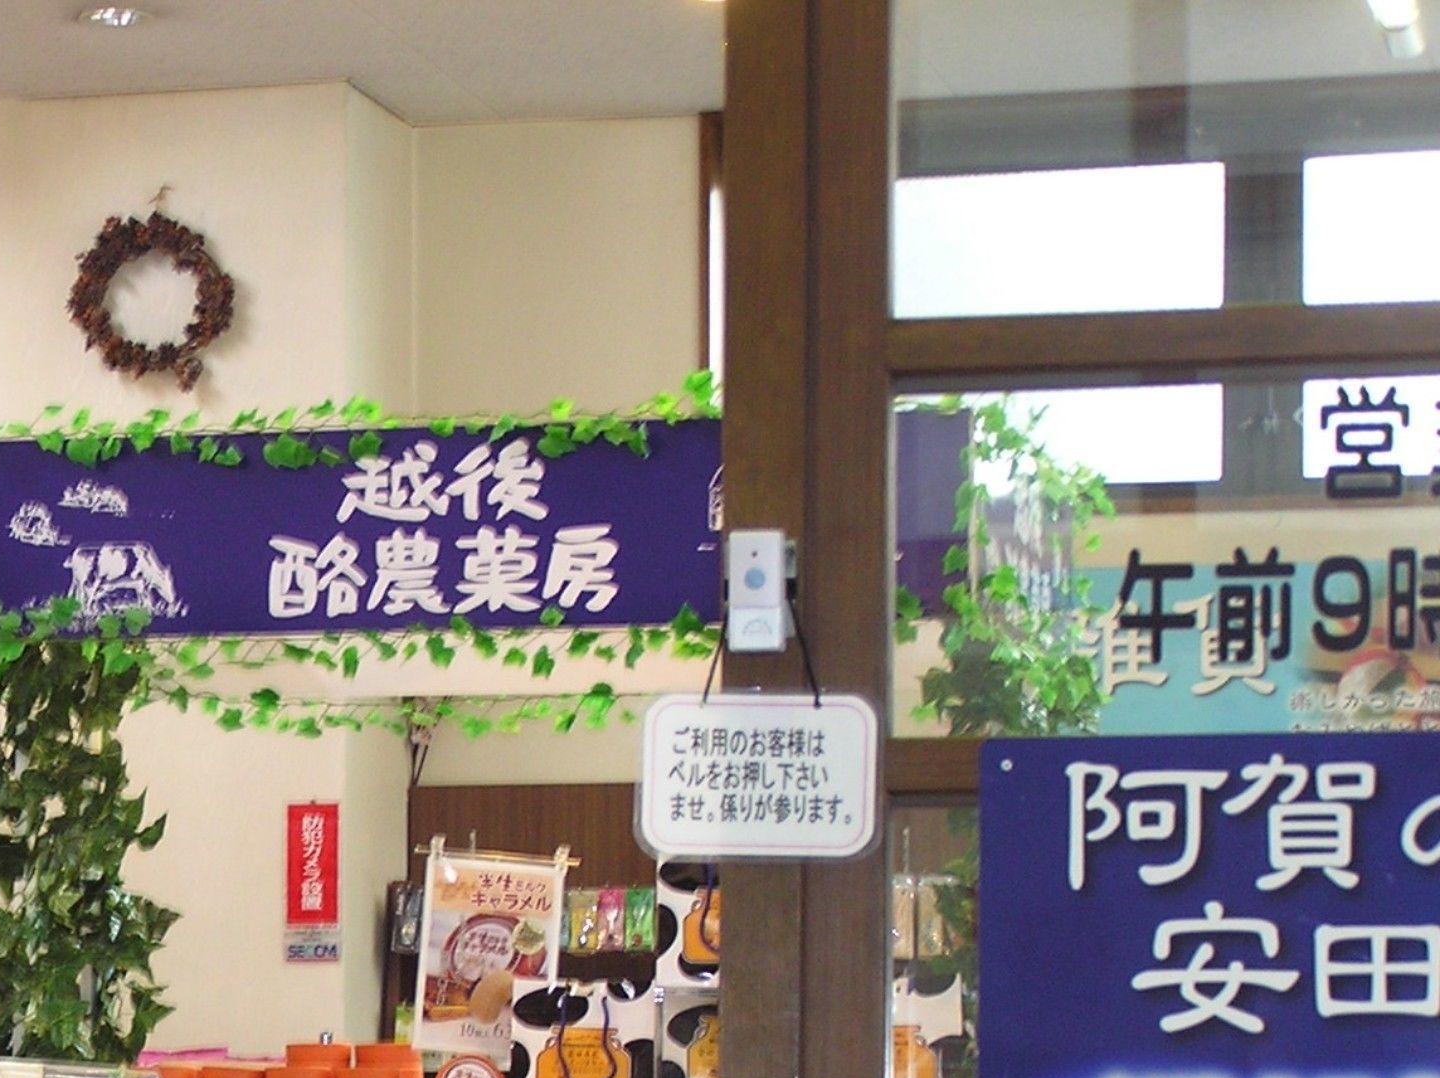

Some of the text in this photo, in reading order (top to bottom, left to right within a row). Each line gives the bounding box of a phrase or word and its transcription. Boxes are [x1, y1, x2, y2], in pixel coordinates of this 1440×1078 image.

[336, 438, 550, 523] 越後
[268, 524, 620, 619] 酪農菓房
[672, 726, 825, 757] ご利用のお客様は
[669, 762, 828, 791] ベルをお押し下さい
[670, 793, 852, 824] ませ。係りが参ります。
[471, 893, 552, 912] キャラメル
